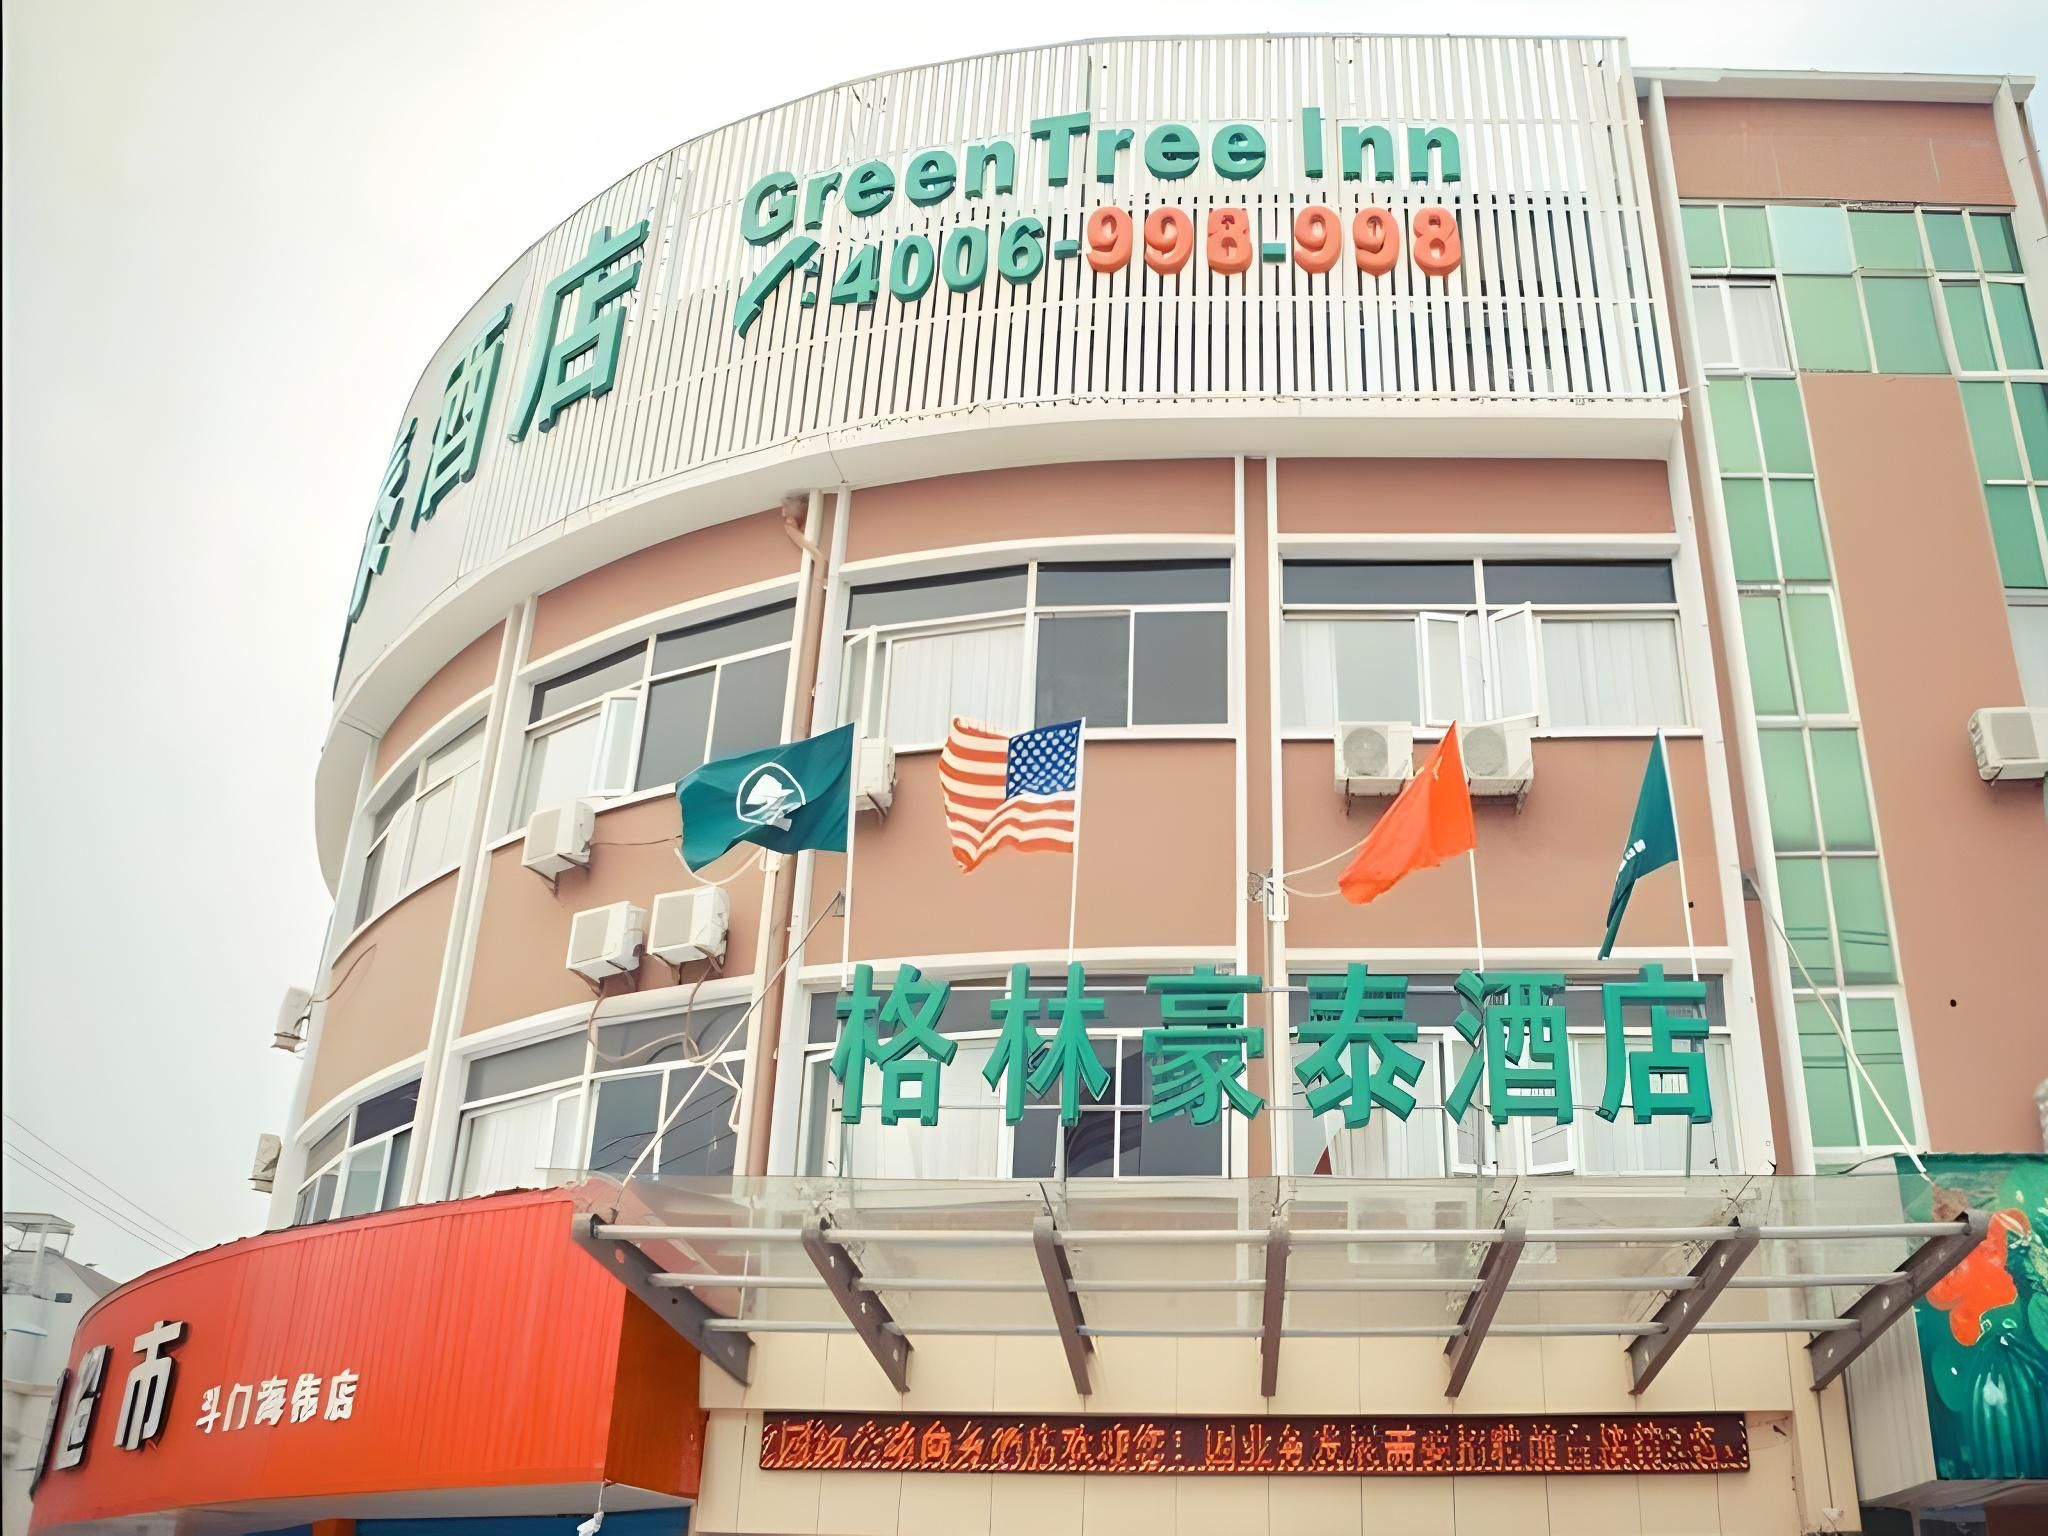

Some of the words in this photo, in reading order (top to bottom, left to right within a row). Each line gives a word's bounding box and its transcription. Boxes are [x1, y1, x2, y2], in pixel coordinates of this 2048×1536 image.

[1301, 106, 1461, 184] Inn
[829, 963, 1712, 1129] 格林豪泰酒店
